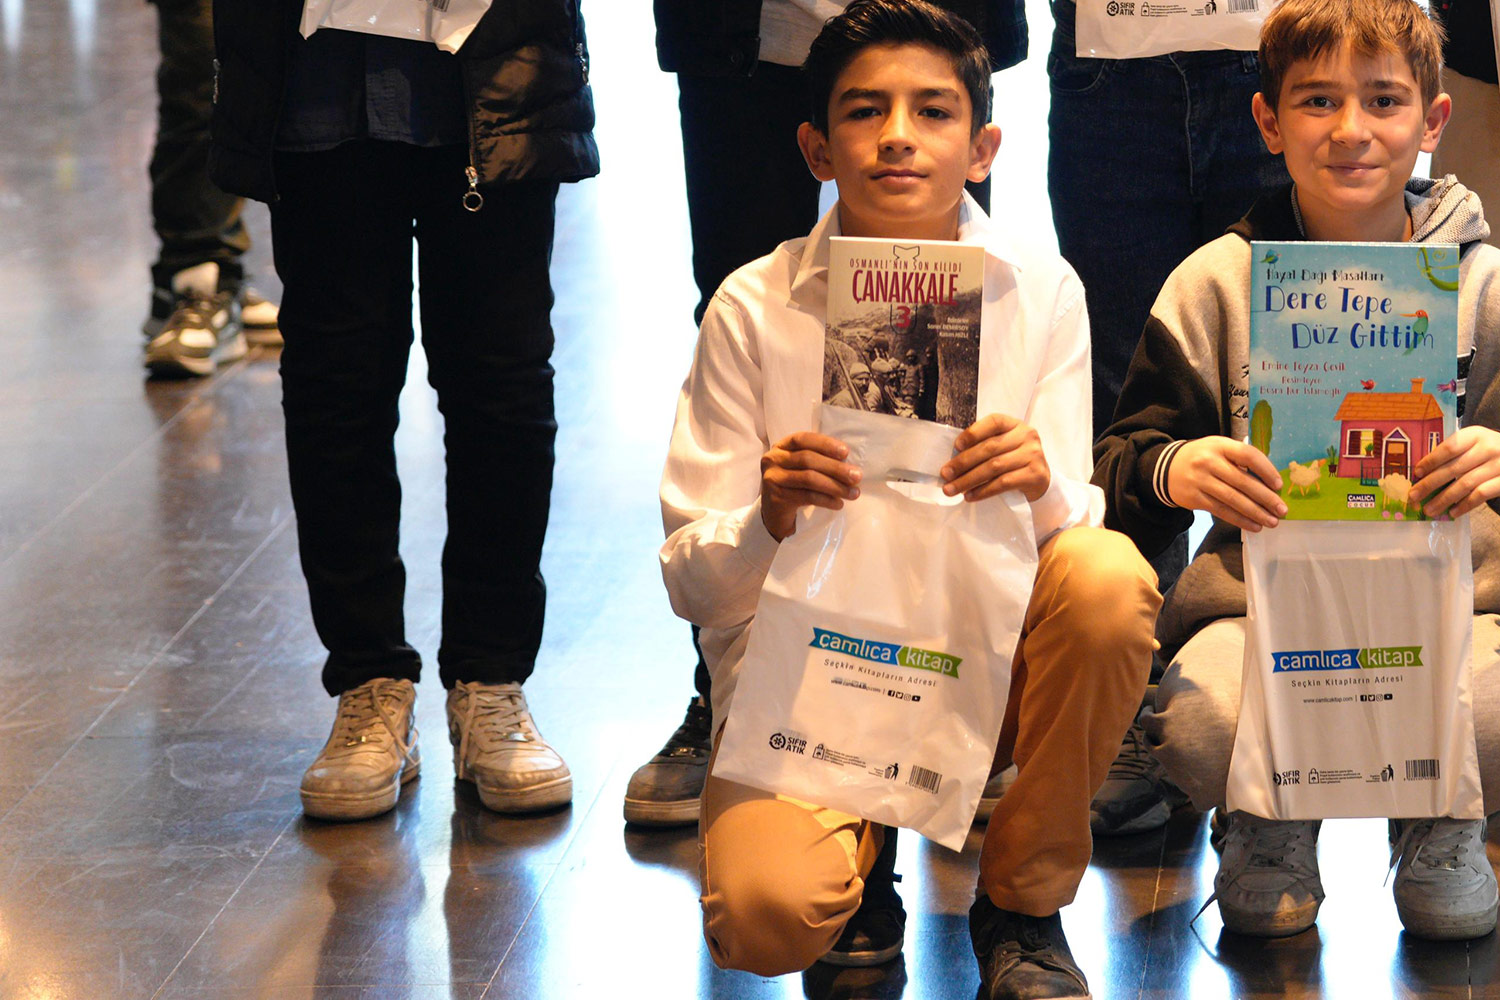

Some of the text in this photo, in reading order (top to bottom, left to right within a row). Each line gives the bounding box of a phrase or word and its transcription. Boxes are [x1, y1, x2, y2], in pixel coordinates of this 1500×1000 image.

[849, 258, 908, 270] OSMANLI'NIN
[913, 260, 929, 271] SON
[1267, 268, 1296, 283] Hayal
[852, 269, 959, 307] ÇANAKKALE
[1265, 285, 1393, 320] Dere Tepe
[896, 306, 911, 328] 3
[1291, 322, 1434, 349] Düz Gittim
[818, 631, 953, 674] çamlıca kitap
[1279, 648, 1415, 671] çamlıca kitap
[823, 658, 937, 688] Seçkin Kitapların Adresi
[1291, 675, 1403, 688] Seçkin Kitapların Adresi
[785, 744, 805, 755] ATIK
[787, 737, 807, 747] SIFIR
[1282, 777, 1301, 786] ATIK
